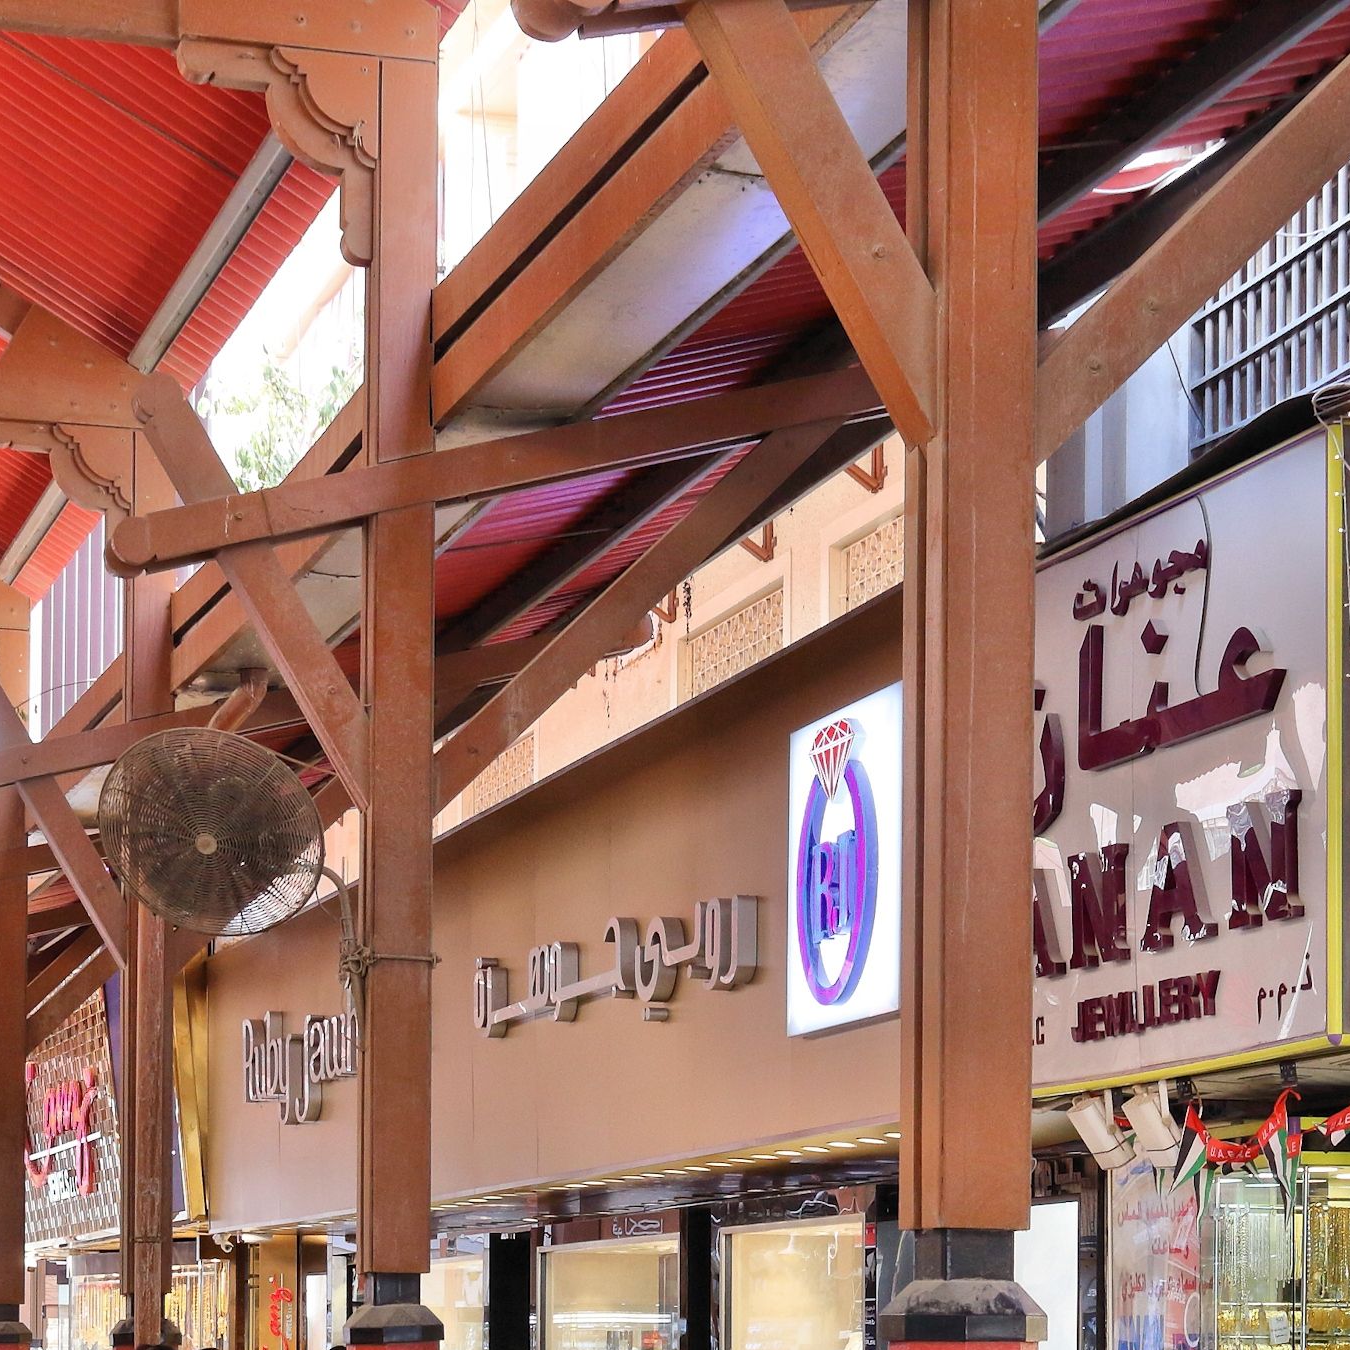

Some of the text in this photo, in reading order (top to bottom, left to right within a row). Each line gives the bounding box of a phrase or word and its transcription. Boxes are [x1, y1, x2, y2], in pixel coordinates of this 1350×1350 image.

[1072, 538, 1207, 622] مجوهرات
[1034, 788, 1304, 978] NAN
[242, 1010, 301, 1126] Ruby
